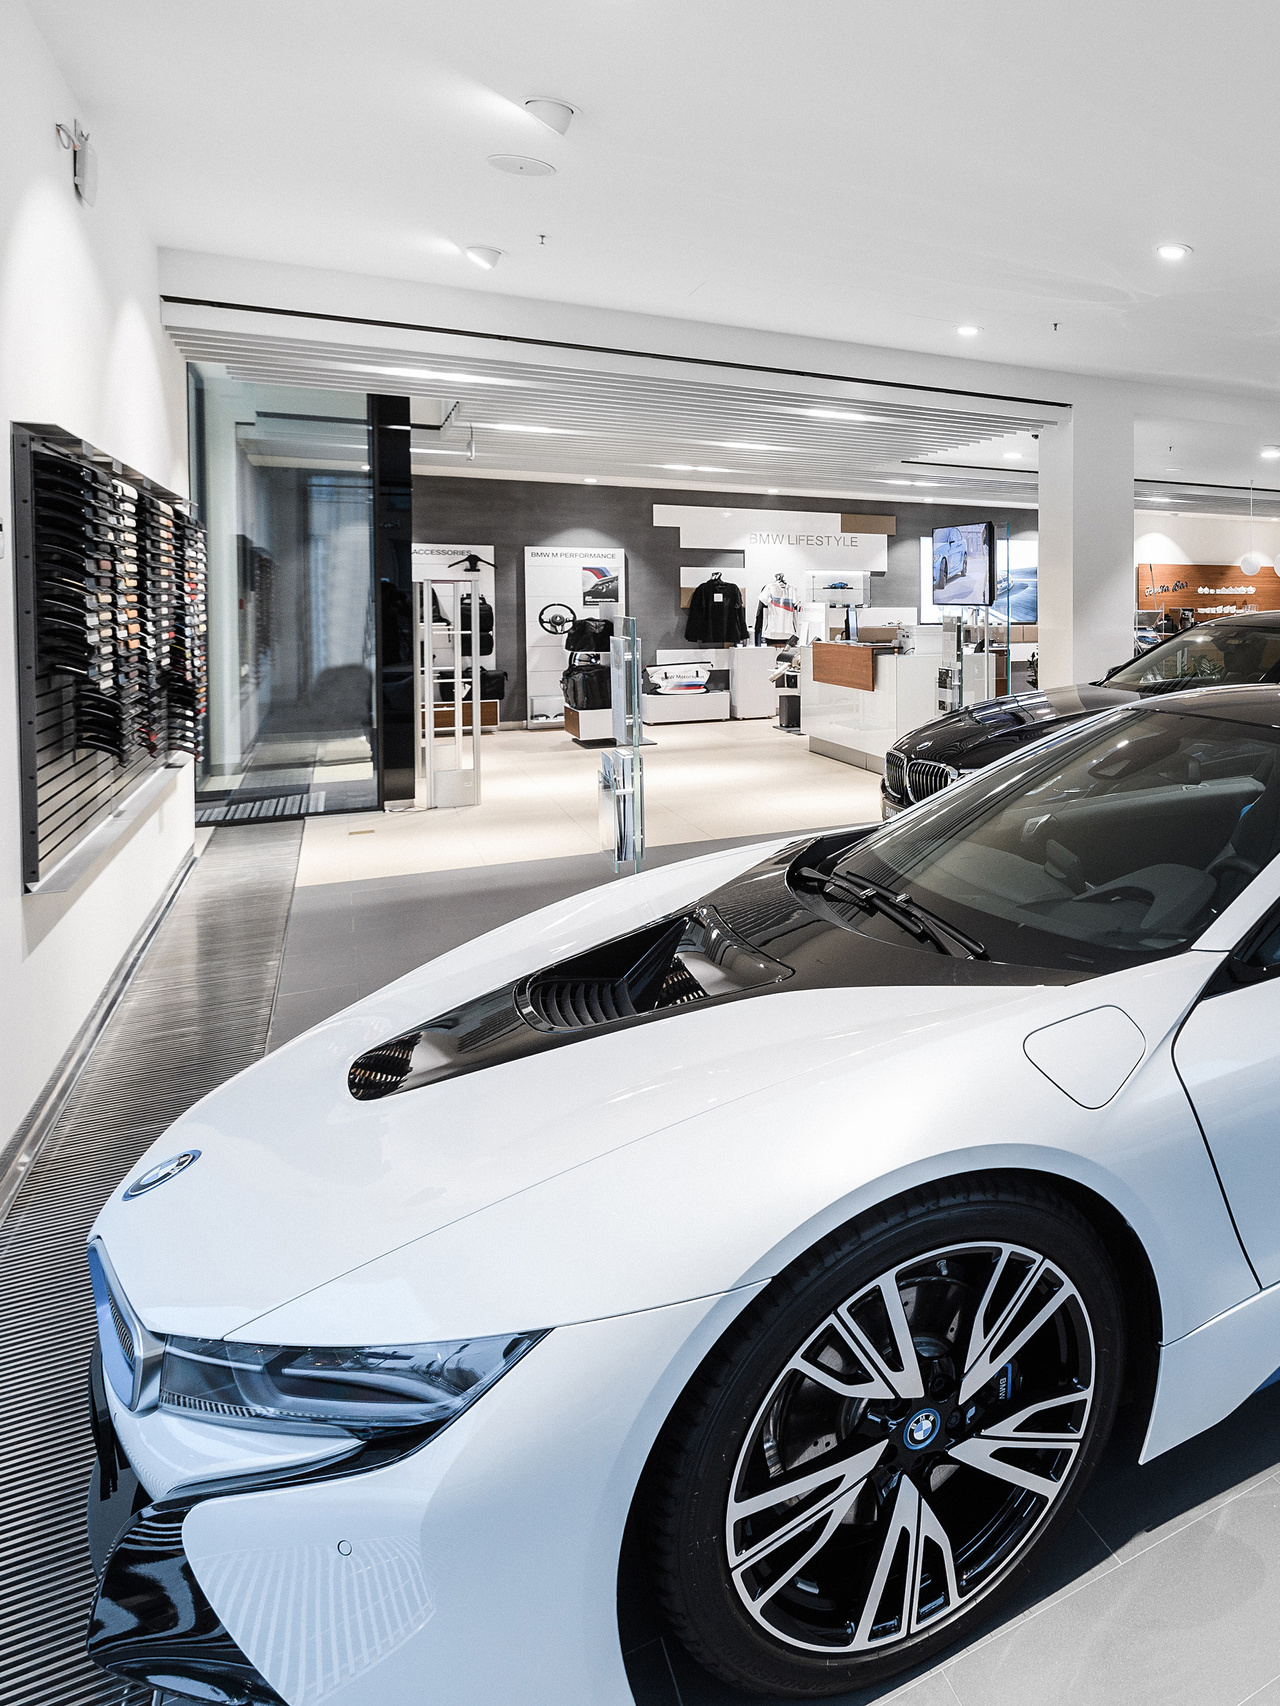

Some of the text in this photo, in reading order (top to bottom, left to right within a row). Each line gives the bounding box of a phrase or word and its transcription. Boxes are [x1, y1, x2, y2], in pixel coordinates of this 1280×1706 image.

[749, 533, 859, 547] BMW LIFESTYLE
[998, 1377, 1007, 1400] BMW
